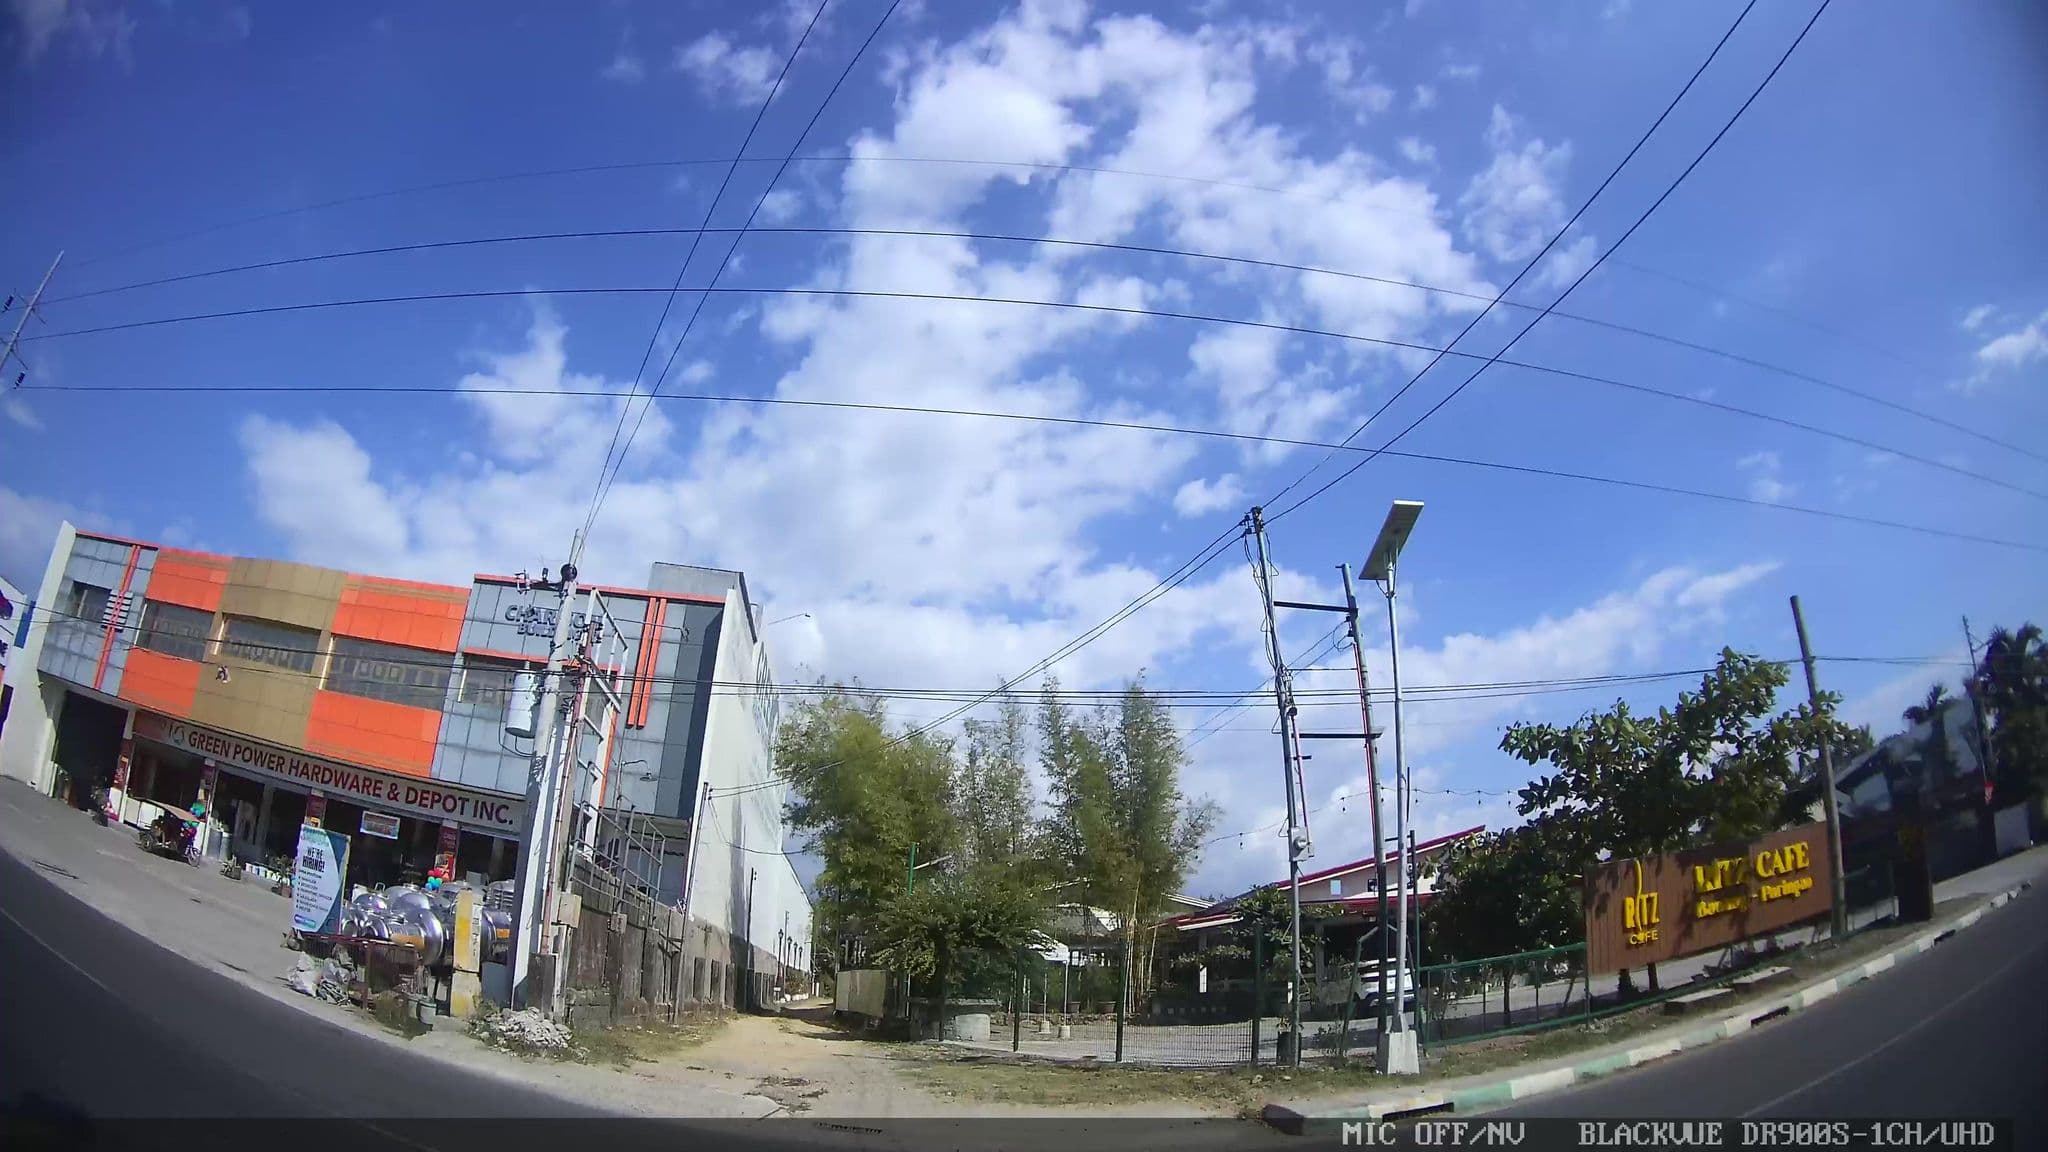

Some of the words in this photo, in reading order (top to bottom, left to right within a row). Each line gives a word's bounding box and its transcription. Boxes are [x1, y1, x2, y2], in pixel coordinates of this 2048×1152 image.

[188, 730, 232, 759] GREEN
[232, 744, 286, 774] POWER
[287, 759, 384, 798] HARDWARE
[386, 783, 401, 802] &
[404, 786, 470, 816] DEPOT
[472, 799, 514, 826] INC.
[1756, 842, 1809, 877] CAFE
[1625, 862, 1660, 930] RITZ
